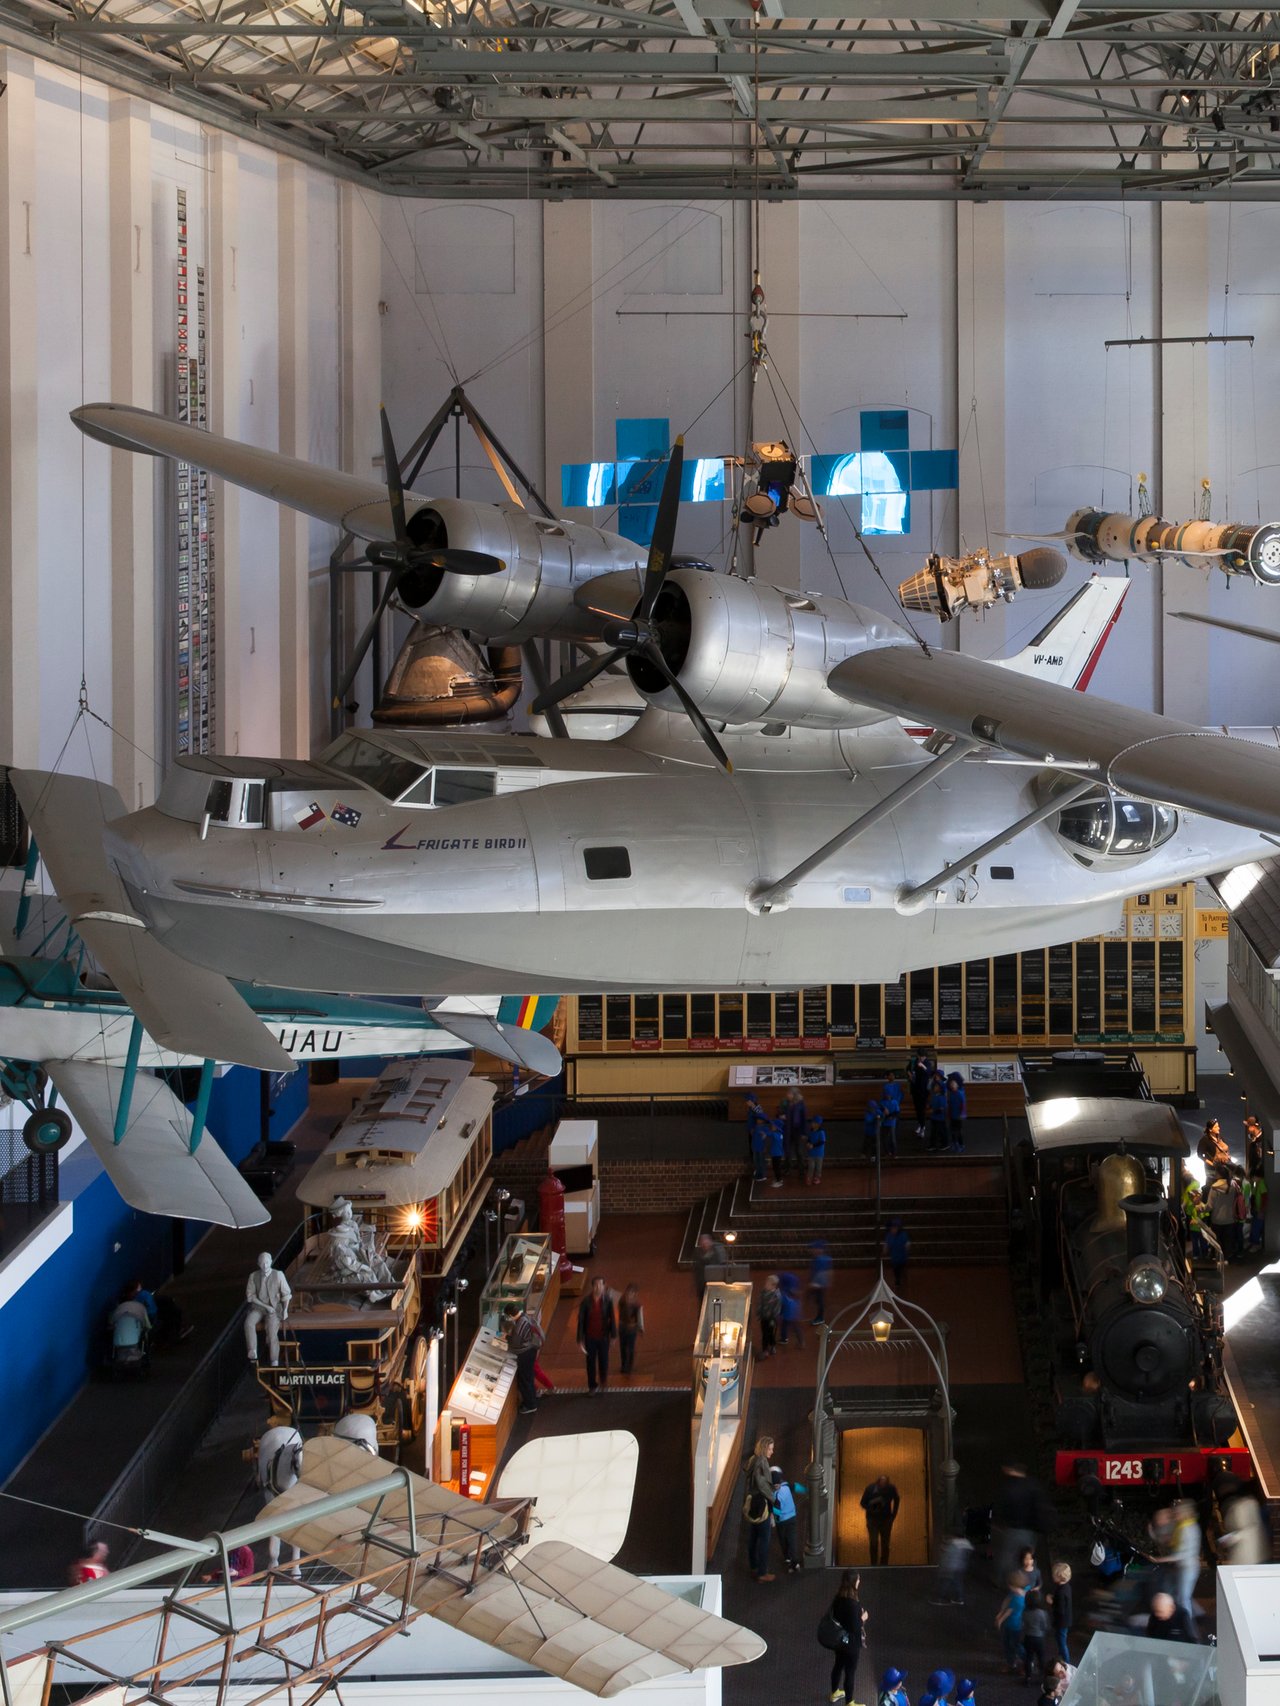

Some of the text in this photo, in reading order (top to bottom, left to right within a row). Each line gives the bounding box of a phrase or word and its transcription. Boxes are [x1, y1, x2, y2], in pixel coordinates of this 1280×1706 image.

[1034, 654, 1064, 666] VH-AMB
[416, 838, 527, 850] FRIGATE BIRD II
[1221, 923, 1229, 932] 5
[279, 1029, 343, 1053] UAU
[279, 1374, 346, 1385] MARTIN PLACE
[1105, 1460, 1143, 1480] 1243
